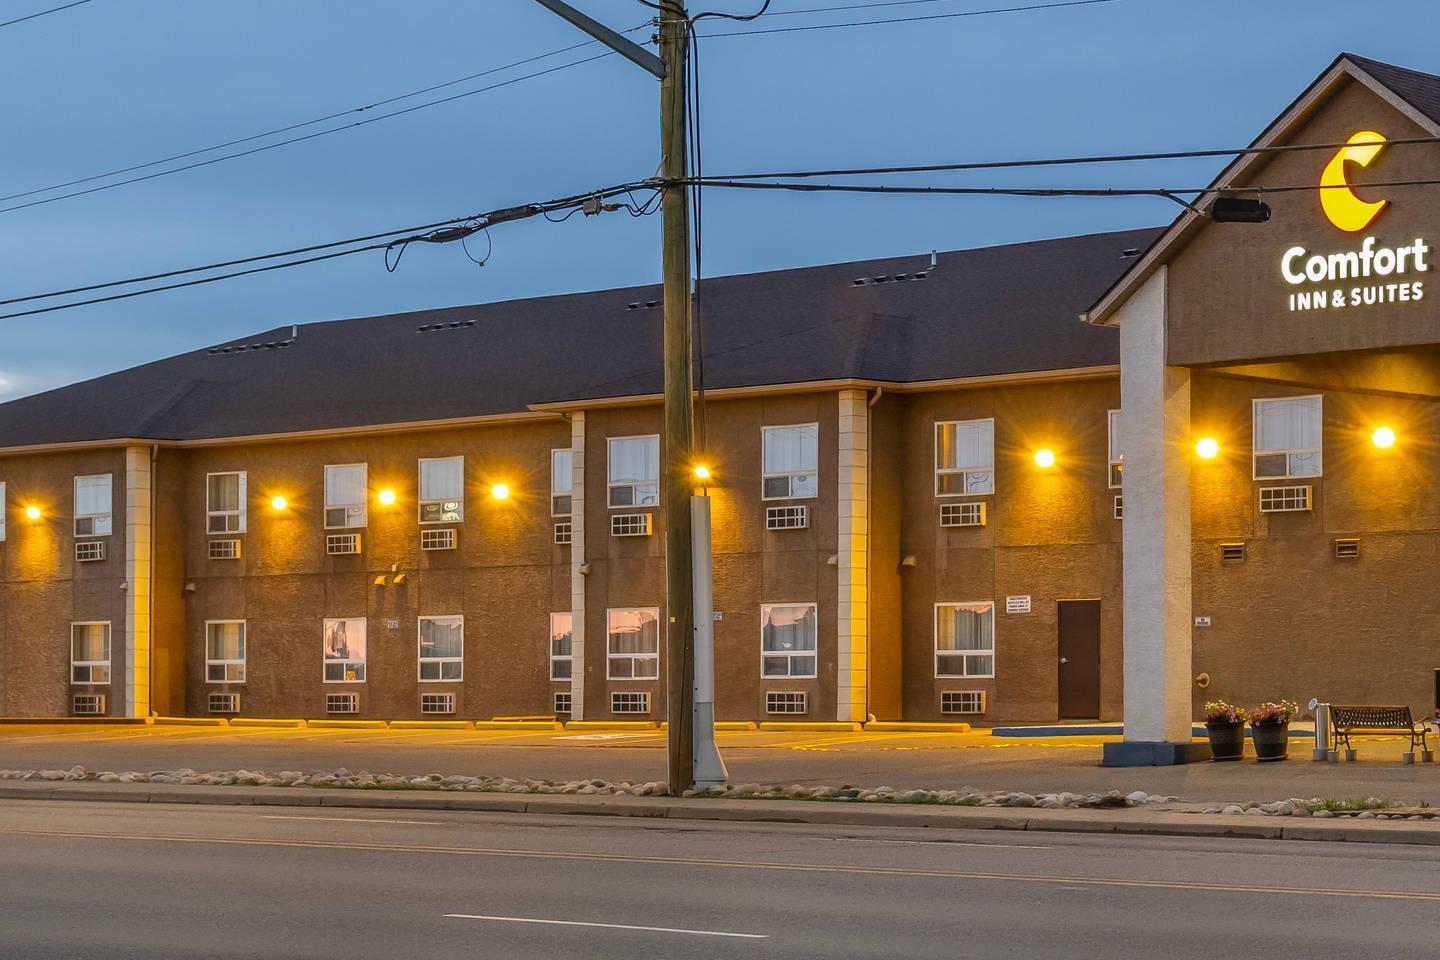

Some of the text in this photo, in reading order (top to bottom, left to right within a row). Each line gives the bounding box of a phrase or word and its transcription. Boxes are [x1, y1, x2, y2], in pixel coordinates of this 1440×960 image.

[1281, 237, 1428, 284] Comfort
[1290, 282, 1423, 311] INN & SUITES
